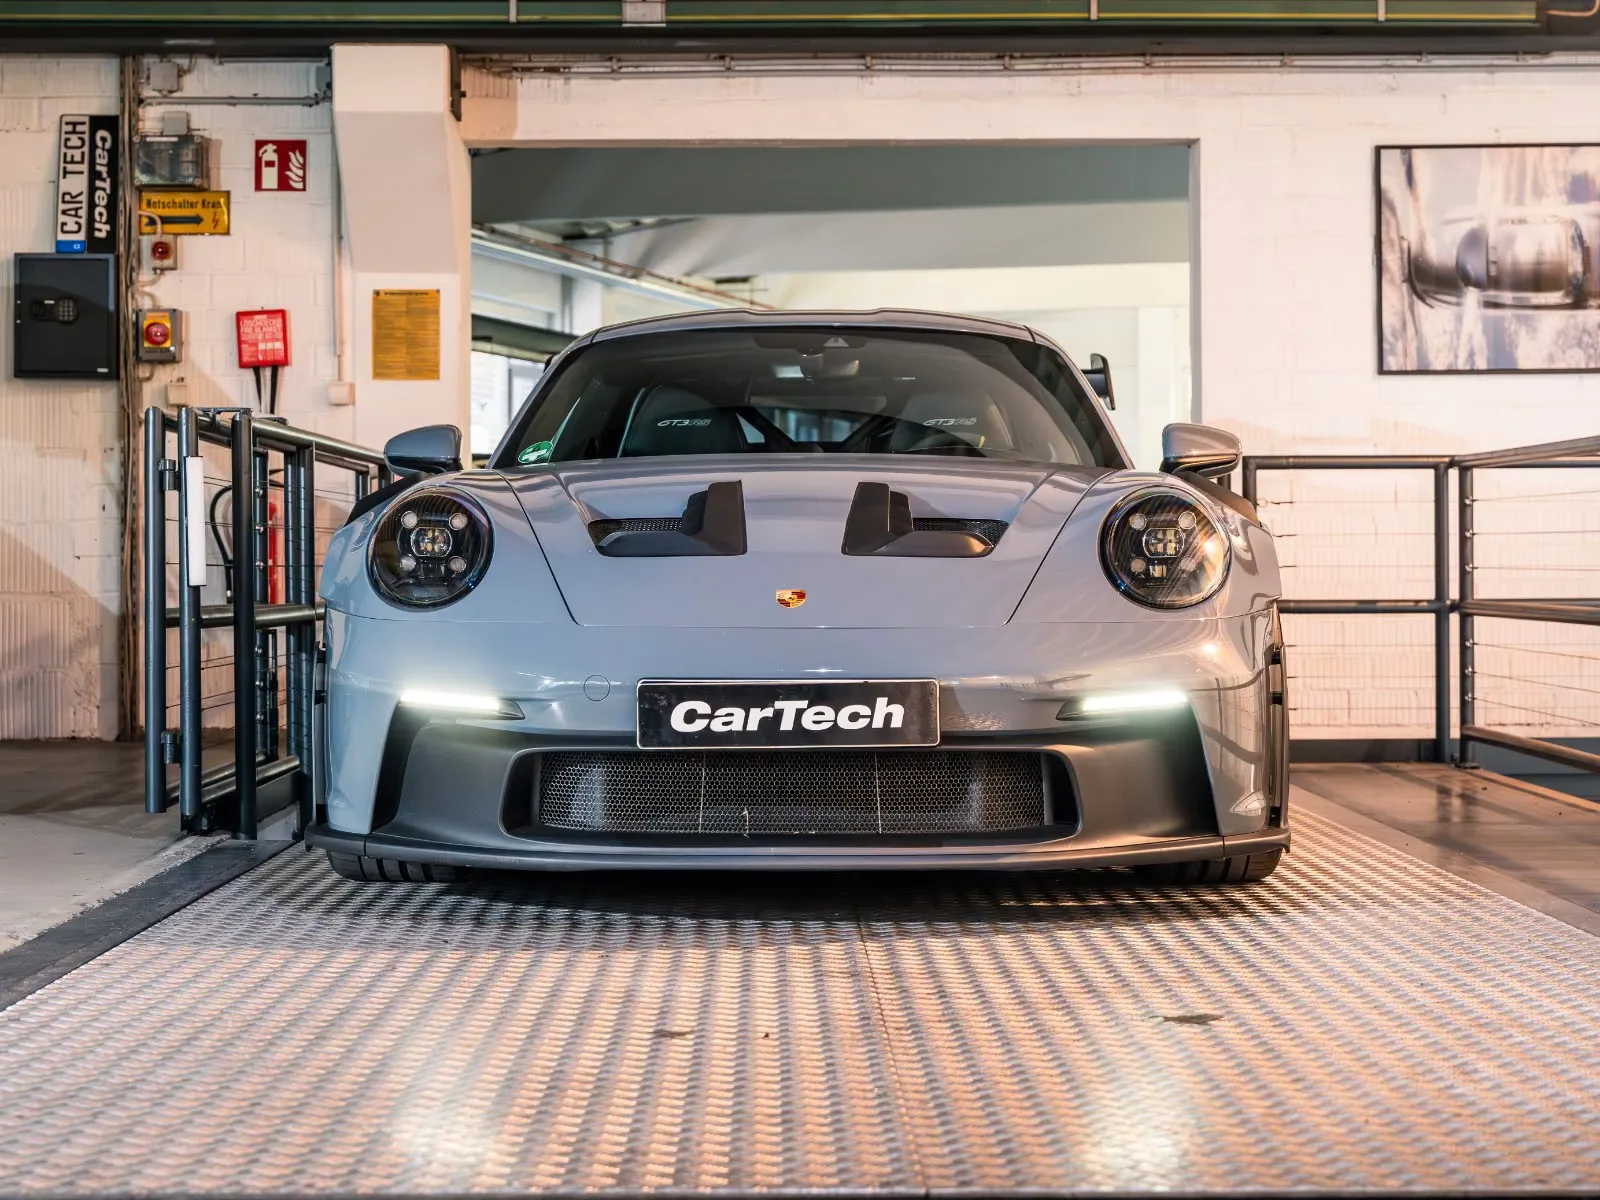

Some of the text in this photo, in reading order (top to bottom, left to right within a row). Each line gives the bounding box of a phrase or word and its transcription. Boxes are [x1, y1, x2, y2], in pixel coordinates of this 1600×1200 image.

[60, 121, 87, 235] CAR TECH
[94, 129, 113, 239] CarTech
[670, 697, 905, 733] CarTech
